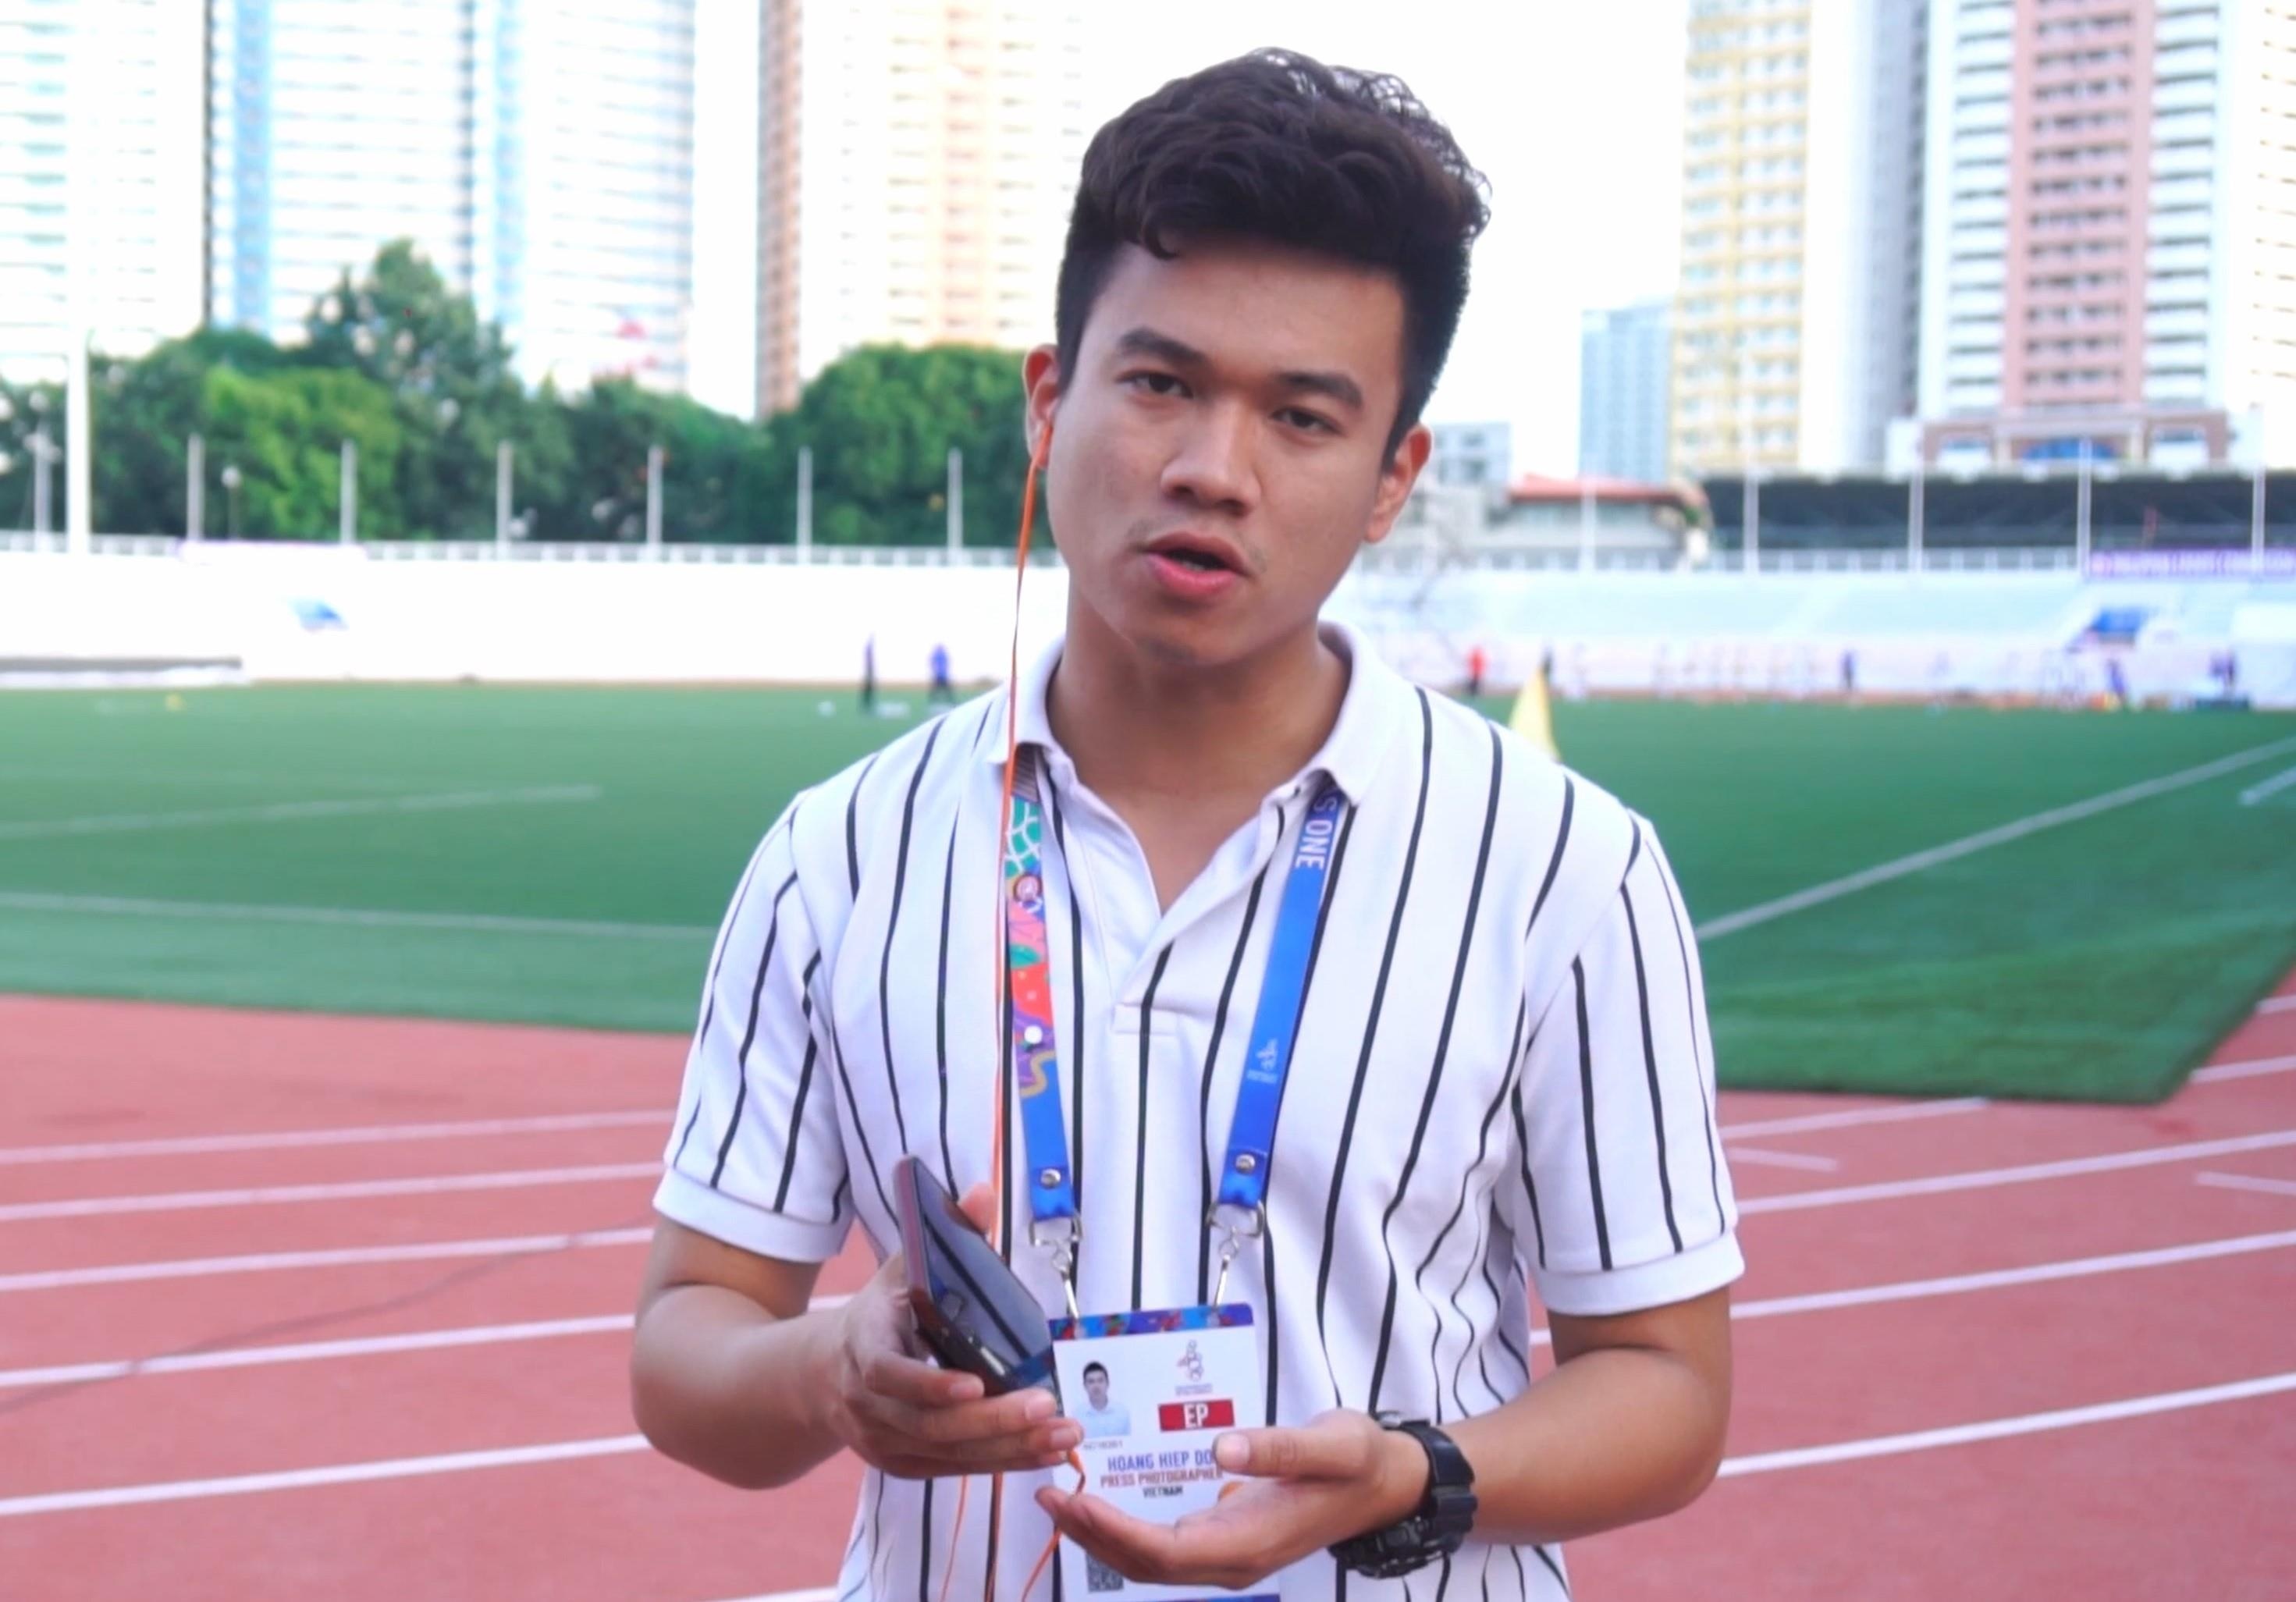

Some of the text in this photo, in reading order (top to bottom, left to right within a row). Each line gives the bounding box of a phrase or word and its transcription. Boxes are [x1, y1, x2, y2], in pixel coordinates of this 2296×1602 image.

[1295, 819, 1333, 870] ONE
[1183, 1403, 1209, 1428] EP
[1107, 1453, 1154, 1472] HOANG
[1158, 1451, 1189, 1469] HIEP
[1100, 1466, 1223, 1488] PRESS PHOTOGRAPHER
[1143, 1486, 1184, 1498] VIETNAM
